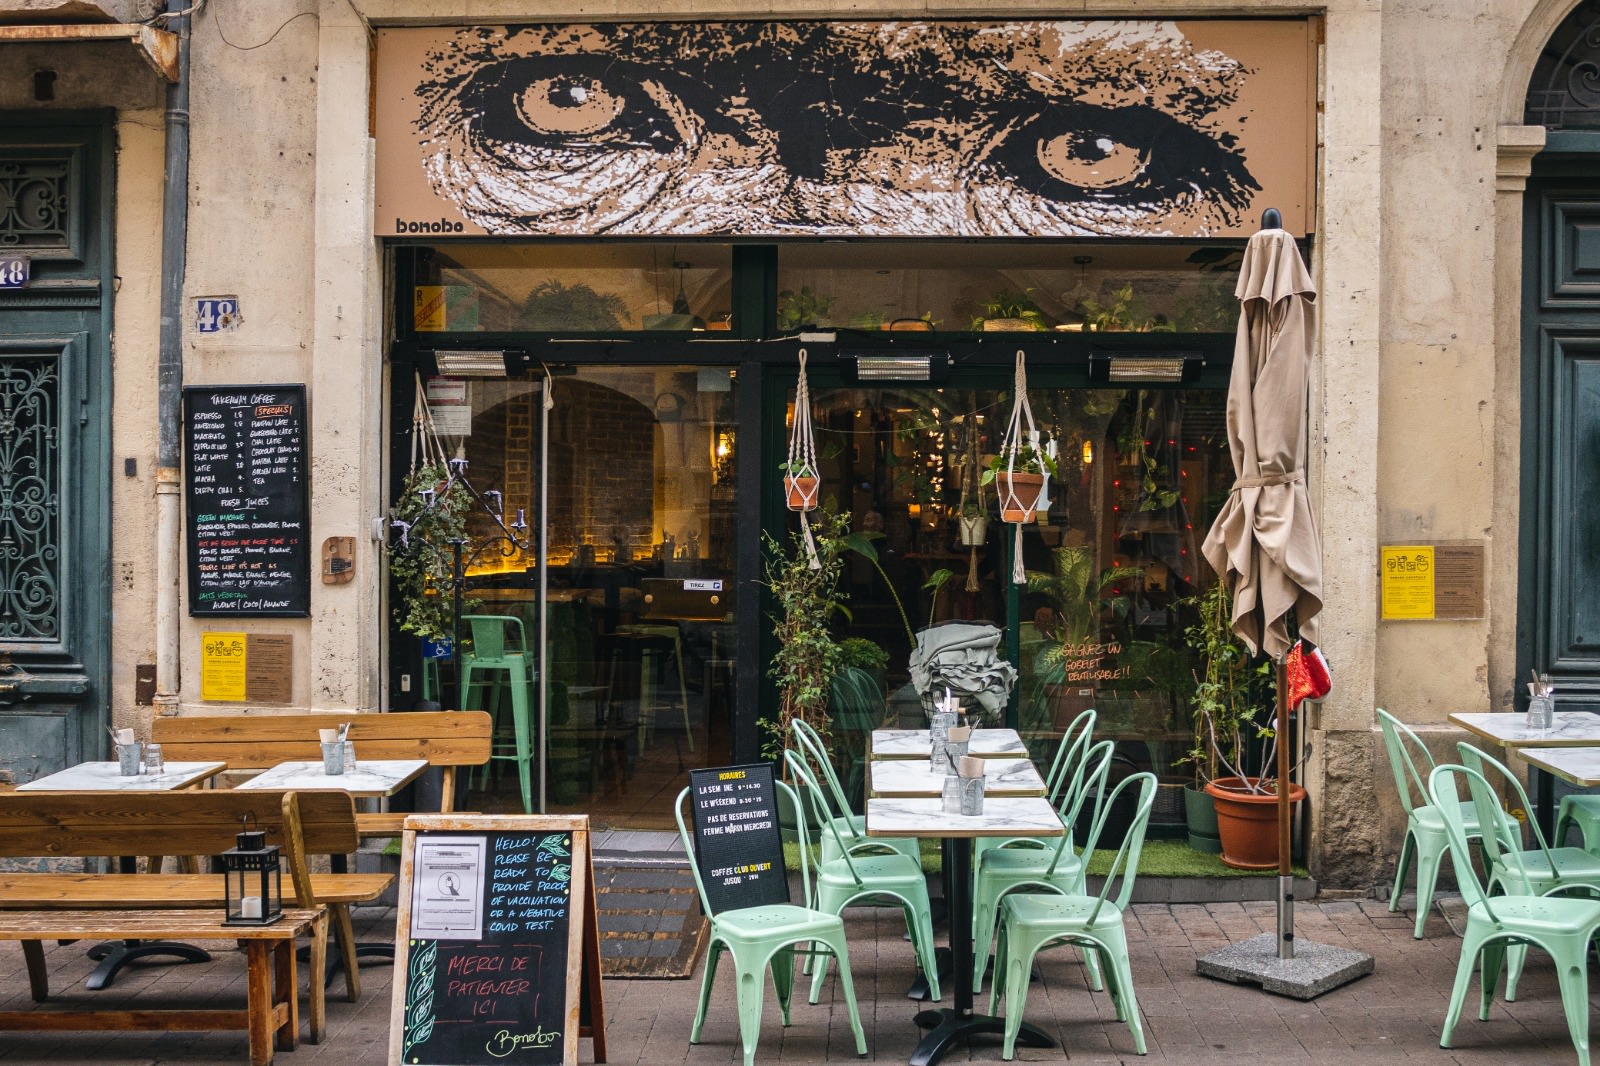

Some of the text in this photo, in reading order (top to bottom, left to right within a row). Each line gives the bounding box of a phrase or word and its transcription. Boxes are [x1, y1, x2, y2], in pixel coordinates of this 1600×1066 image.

[396, 218, 463, 233] bonobo
[200, 301, 234, 332] 48
[211, 394, 276, 405] TAKEAWAY COFFEE
[194, 412, 222, 420] ESPRESSO
[258, 407, 289, 416] SPECIALS
[194, 454, 209, 462] FLAT
[194, 464, 212, 472] LATTE
[218, 486, 232, 494] CHAI
[221, 497, 269, 508] FRESH JUICES
[197, 514, 216, 522] GREEN
[263, 600, 291, 609] AMANDE
[1062, 643, 1122, 656] GAGNEZ UN
[1066, 657, 1104, 672] GOBELET
[719, 771, 746, 780] HORAIRES
[699, 786, 708, 794] LA
[700, 800, 708, 808] LE
[710, 798, 736, 808] WEEKEND
[708, 810, 768, 823] PAS DE RESERVATIONS
[704, 826, 724, 836] FERME
[744, 821, 772, 832] MERCREDI
[496, 837, 536, 850] HELLO!
[494, 852, 552, 866] PLEASE BE
[494, 868, 550, 880] READY TO
[711, 862, 772, 877] COFFEE CLUB OUVERT
[492, 881, 568, 894] PROVIDE PROOF
[490, 896, 568, 906] OF VACCINATION
[490, 909, 565, 919] OR A NEGATIVE
[490, 920, 554, 932] COVID TEST.
[448, 956, 530, 976] MERCI DE
[448, 978, 530, 997] PATIENTER
[474, 1000, 497, 1016] ICI
[486, 1025, 562, 1058] Bonobo
